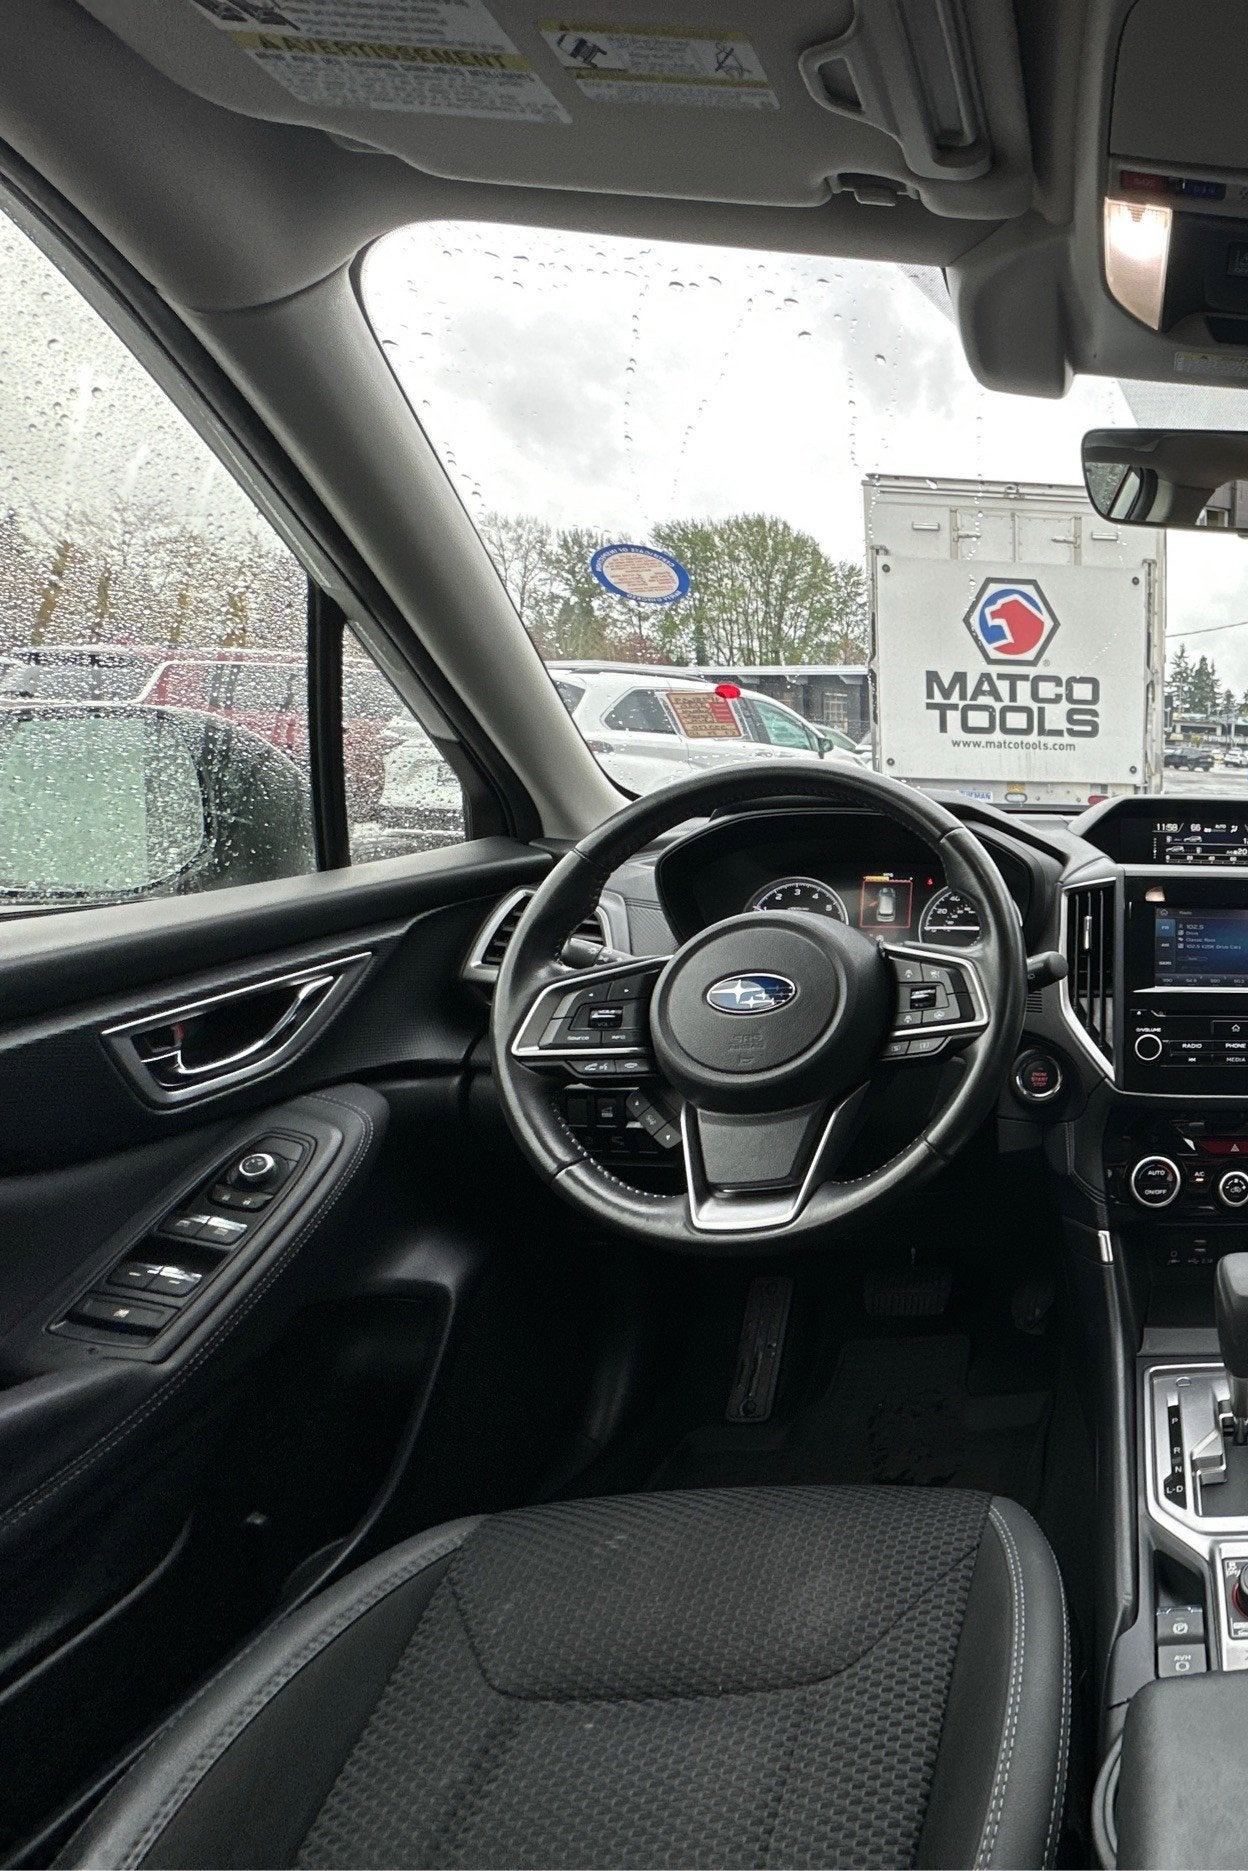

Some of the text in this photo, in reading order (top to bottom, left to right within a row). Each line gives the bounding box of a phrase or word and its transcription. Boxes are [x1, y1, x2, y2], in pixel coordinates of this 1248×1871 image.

[281, 36, 508, 69] AVERTISSEMENT
[925, 669, 1100, 706] MATCO
[925, 702, 1100, 739] TOOLS
[951, 738, 1076, 752] www.matcotools.com
[1171, 1417, 1179, 1425] P
[1173, 1446, 1181, 1454] R
[1174, 1465, 1183, 1473] N
